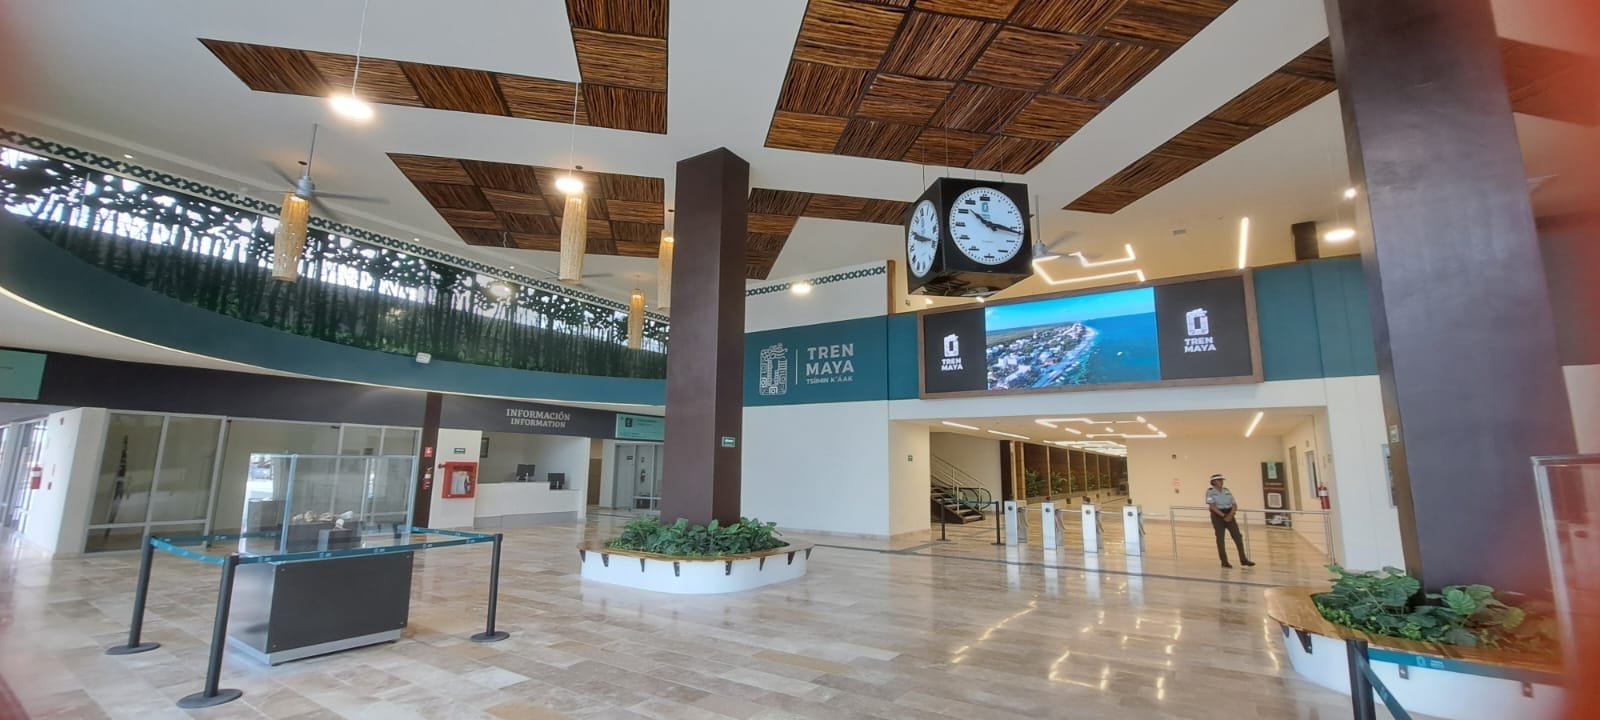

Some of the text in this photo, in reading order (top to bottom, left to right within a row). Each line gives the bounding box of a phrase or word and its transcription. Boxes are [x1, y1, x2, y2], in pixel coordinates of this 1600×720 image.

[1184, 337, 1213, 345] TREN
[807, 343, 854, 360] TREN
[1184, 344, 1216, 353] MAYA
[805, 360, 855, 376] MAYA
[506, 408, 570, 420] INFORMACIÓN
[510, 418, 566, 428] INFORMATION
